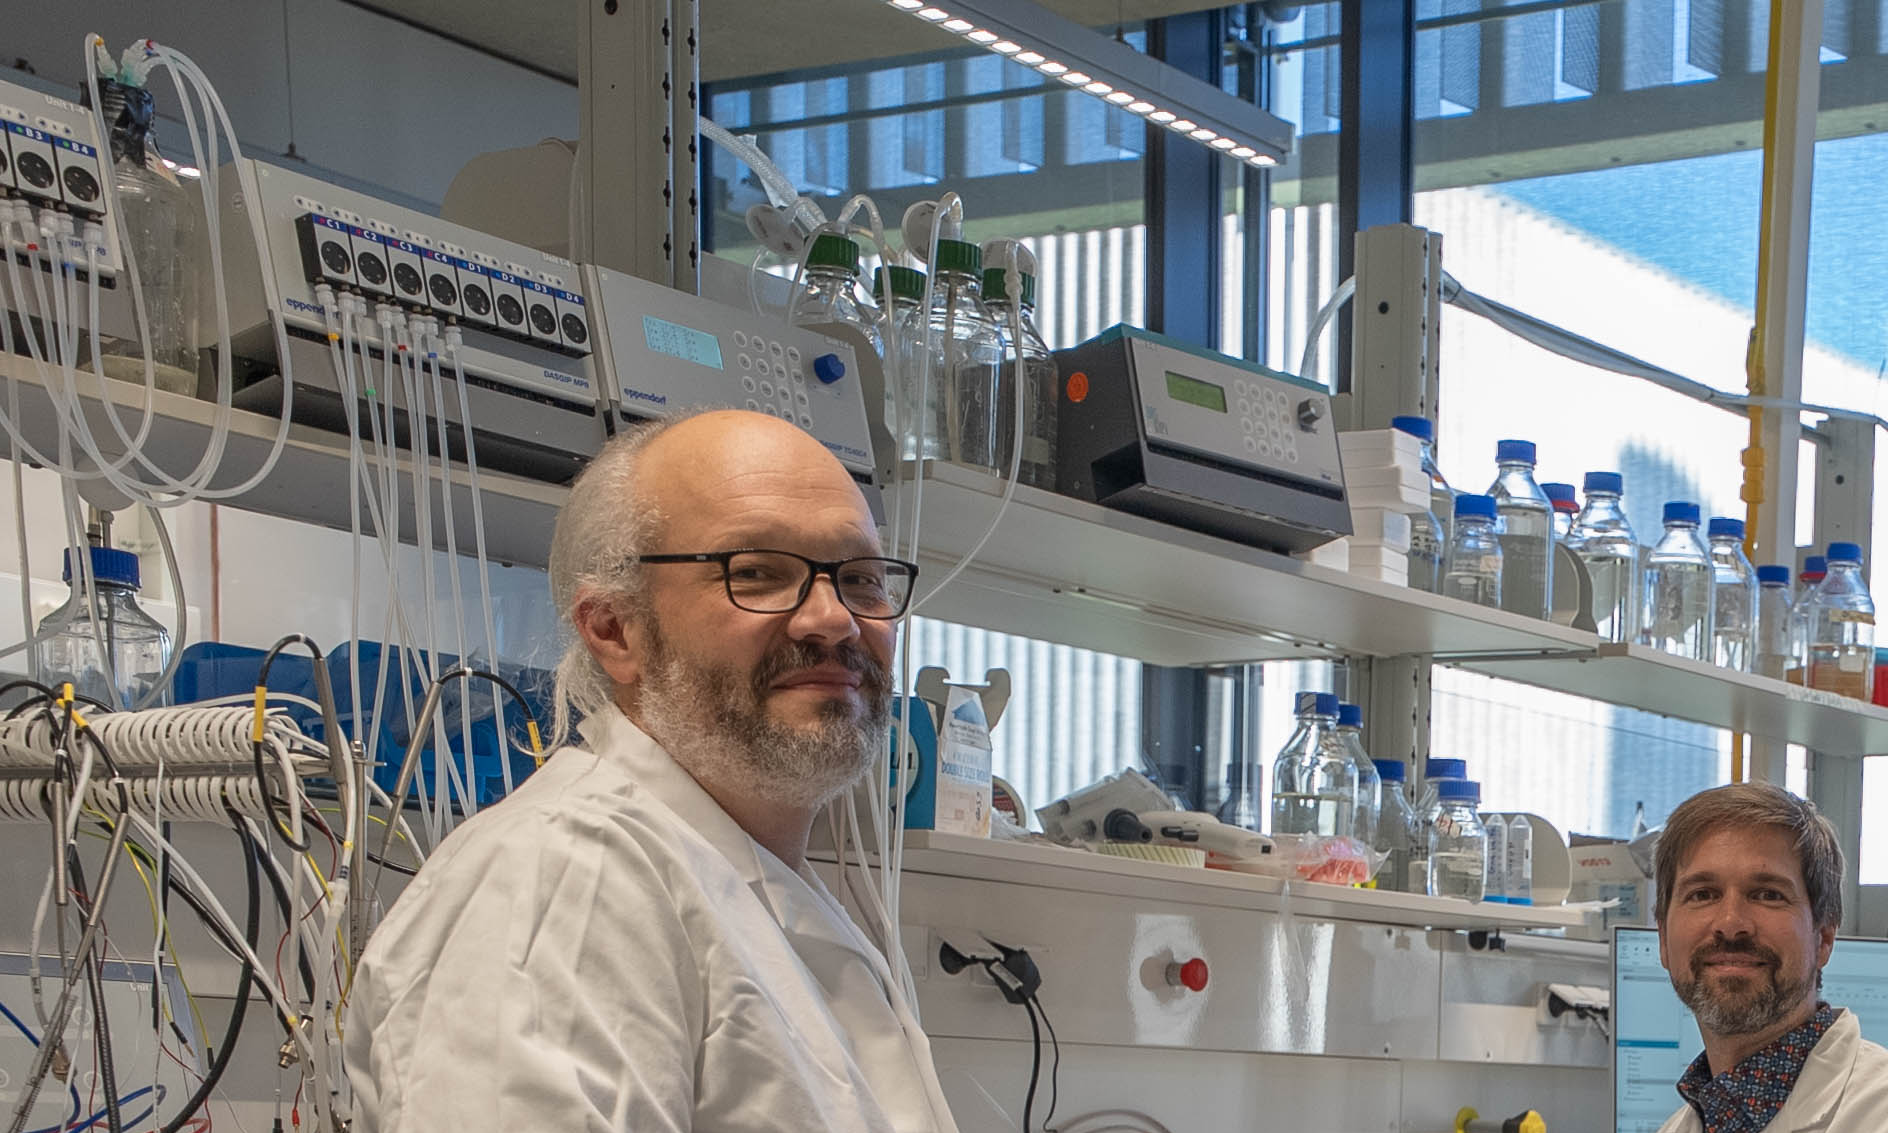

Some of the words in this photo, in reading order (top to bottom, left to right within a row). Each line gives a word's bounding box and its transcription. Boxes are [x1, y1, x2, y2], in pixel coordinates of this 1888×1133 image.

[326, 219, 341, 230] C1
[363, 230, 377, 241] C2
[399, 241, 413, 252] C3
[434, 252, 448, 263] C4
[468, 262, 481, 273] D1
[501, 272, 515, 284] D2
[534, 282, 548, 293] D3
[566, 292, 580, 303] D4
[623, 387, 667, 405] eppendorf
